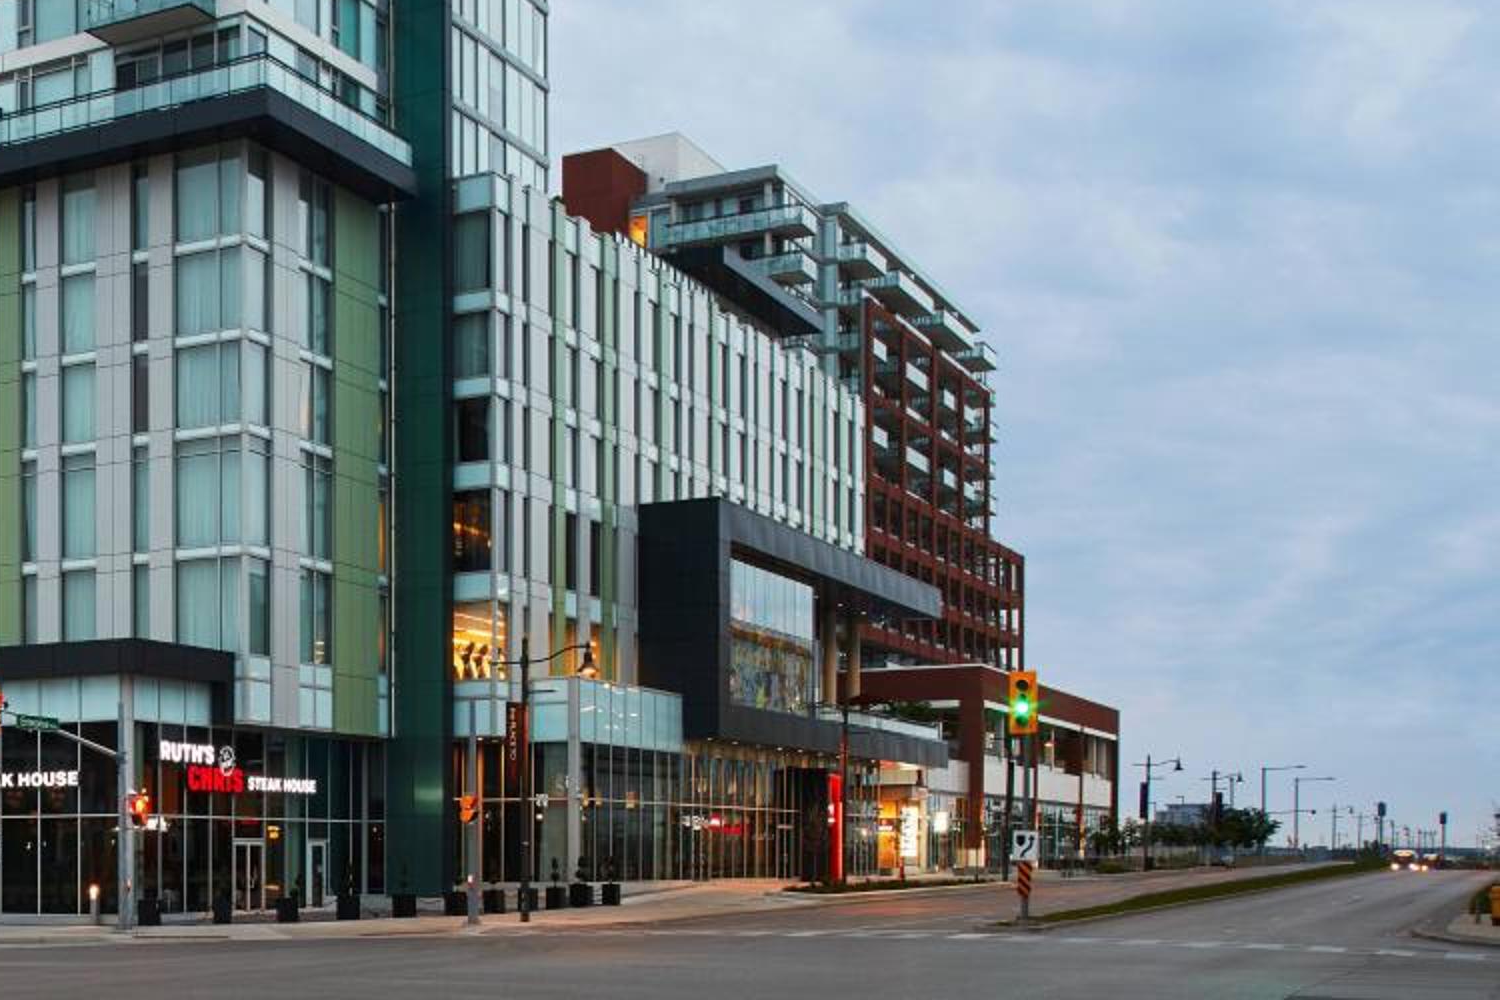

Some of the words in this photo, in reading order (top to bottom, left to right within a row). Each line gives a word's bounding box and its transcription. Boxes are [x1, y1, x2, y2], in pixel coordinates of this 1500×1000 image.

[160, 740, 215, 765] RUTH'S
[17, 770, 79, 787] HOUSE
[187, 765, 244, 792] CHRIS
[247, 776, 282, 791] STEAK
[283, 778, 317, 793] HOUSE
